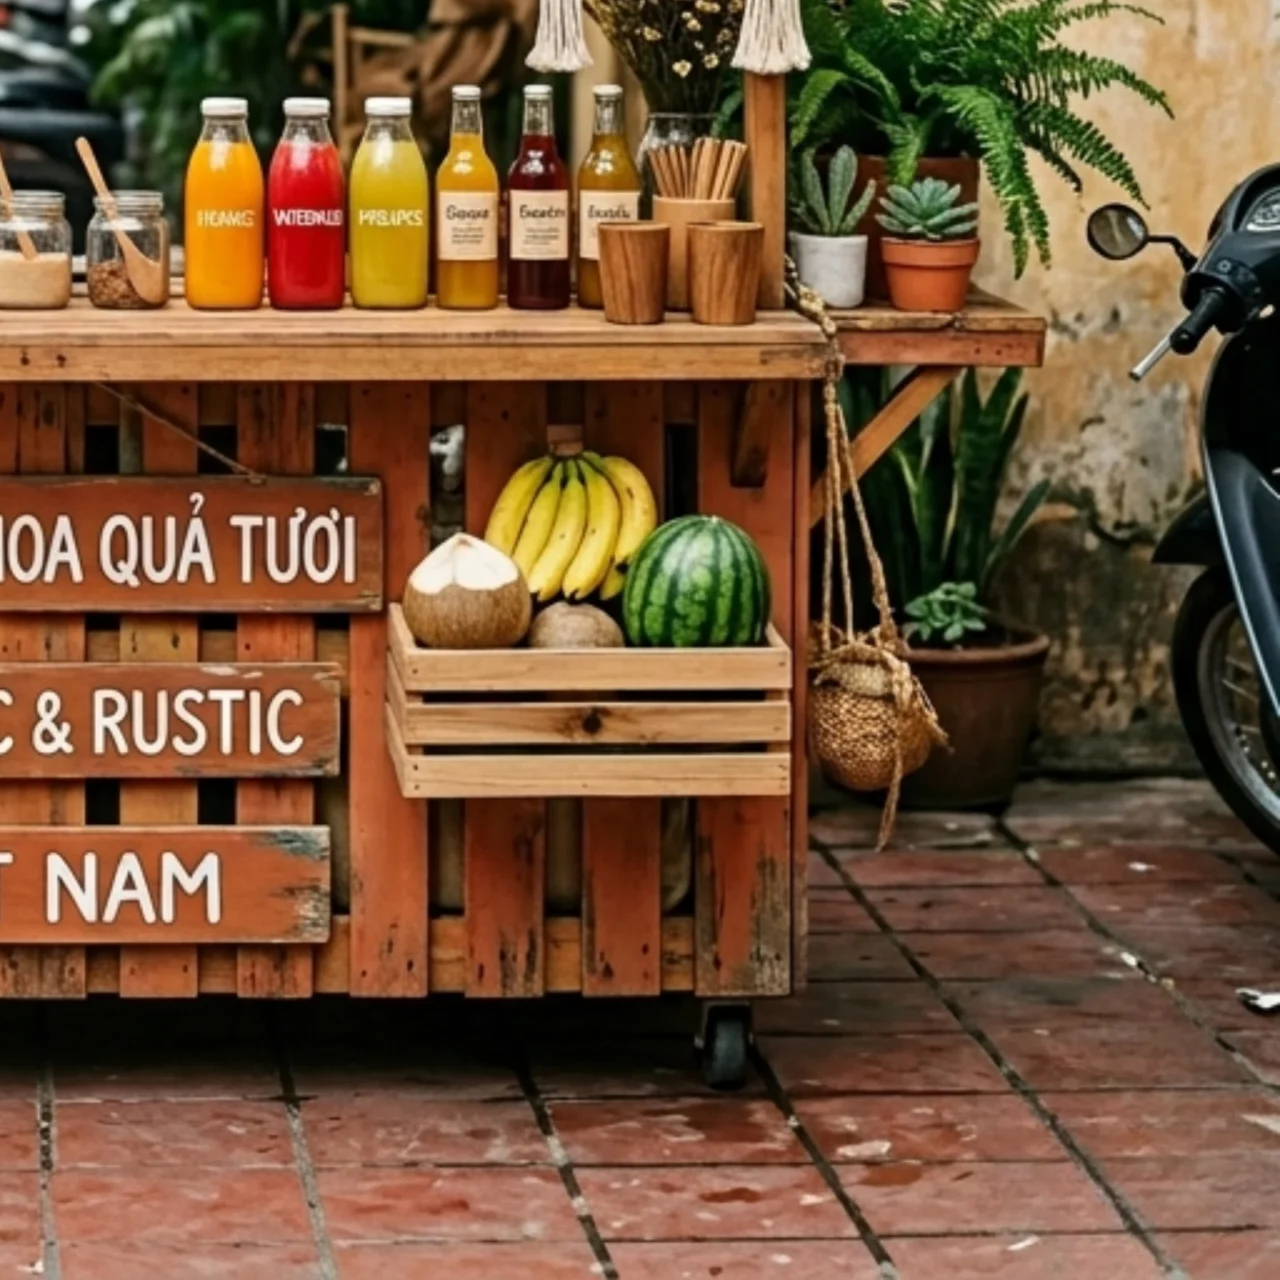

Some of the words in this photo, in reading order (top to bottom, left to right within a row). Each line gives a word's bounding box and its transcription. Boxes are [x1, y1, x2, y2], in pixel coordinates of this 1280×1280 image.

[99, 492, 216, 587] QUẢ
[230, 506, 356, 583] TƯƠI
[32, 689, 74, 755] &
[93, 688, 304, 756] RUSTIC
[45, 851, 222, 924] NAM
